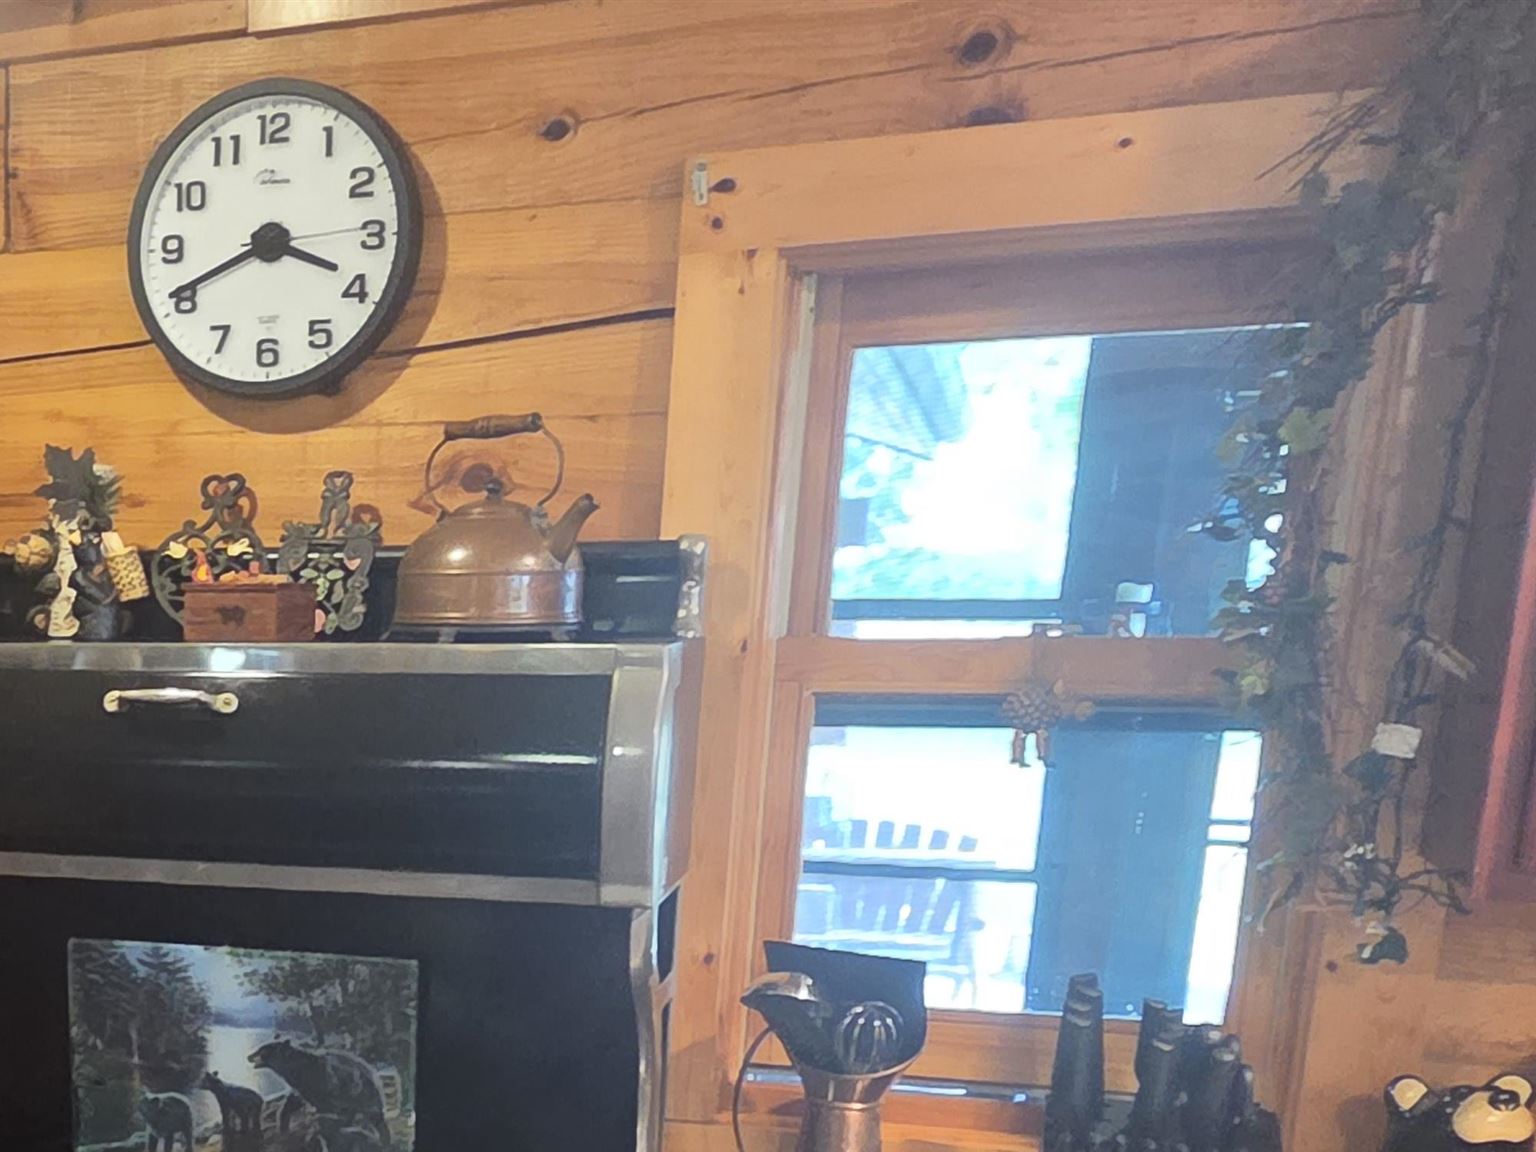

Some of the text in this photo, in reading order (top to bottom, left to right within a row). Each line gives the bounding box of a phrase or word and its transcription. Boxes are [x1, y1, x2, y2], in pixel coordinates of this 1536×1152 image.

[257, 112, 291, 145] 12
[322, 125, 334, 158] 1
[211, 134, 241, 167] 11
[174, 180, 206, 212] 10
[348, 166, 376, 199] 2
[161, 234, 184, 264] 9
[360, 219, 386, 250] 3
[174, 284, 198, 314] 8
[341, 273, 369, 304] 4
[209, 325, 231, 354] 7
[308, 319, 333, 349] 5
[256, 338, 280, 367] 6
